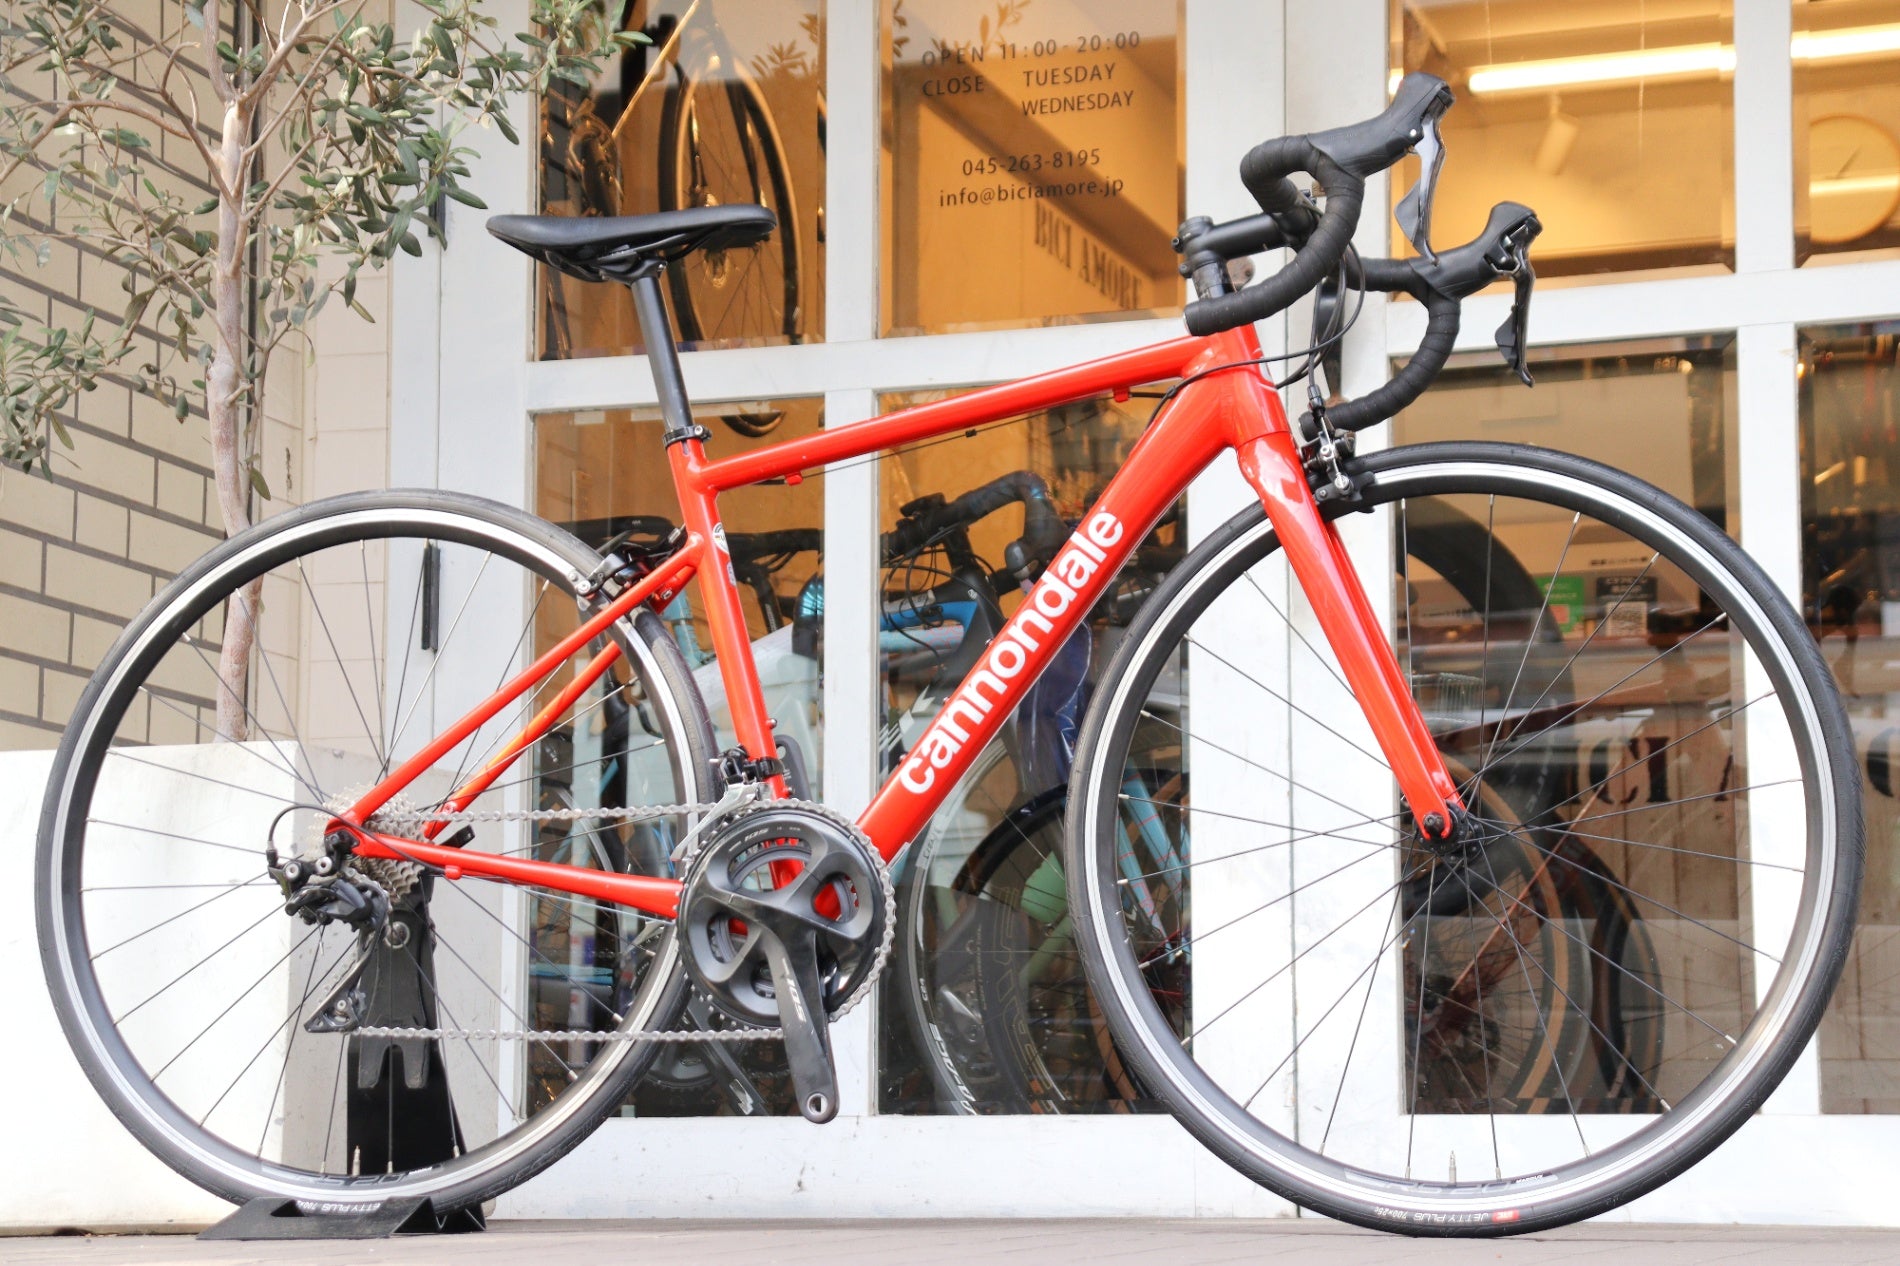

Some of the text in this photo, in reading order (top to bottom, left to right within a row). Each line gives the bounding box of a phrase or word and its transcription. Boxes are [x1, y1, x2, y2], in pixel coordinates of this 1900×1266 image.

[922, 46, 985, 67] OPEN
[922, 63, 1117, 97] CLOSE TUESDAY
[1022, 90, 1135, 117] WEDNESDAY
[962, 148, 1101, 176] 045-263-8195
[939, 177, 1125, 207] info@biciamore.jp
[899, 510, 1124, 795] cannondale
[1413, 1212, 1447, 1222] PLUS
[1447, 1212, 1489, 1222] JETTY
